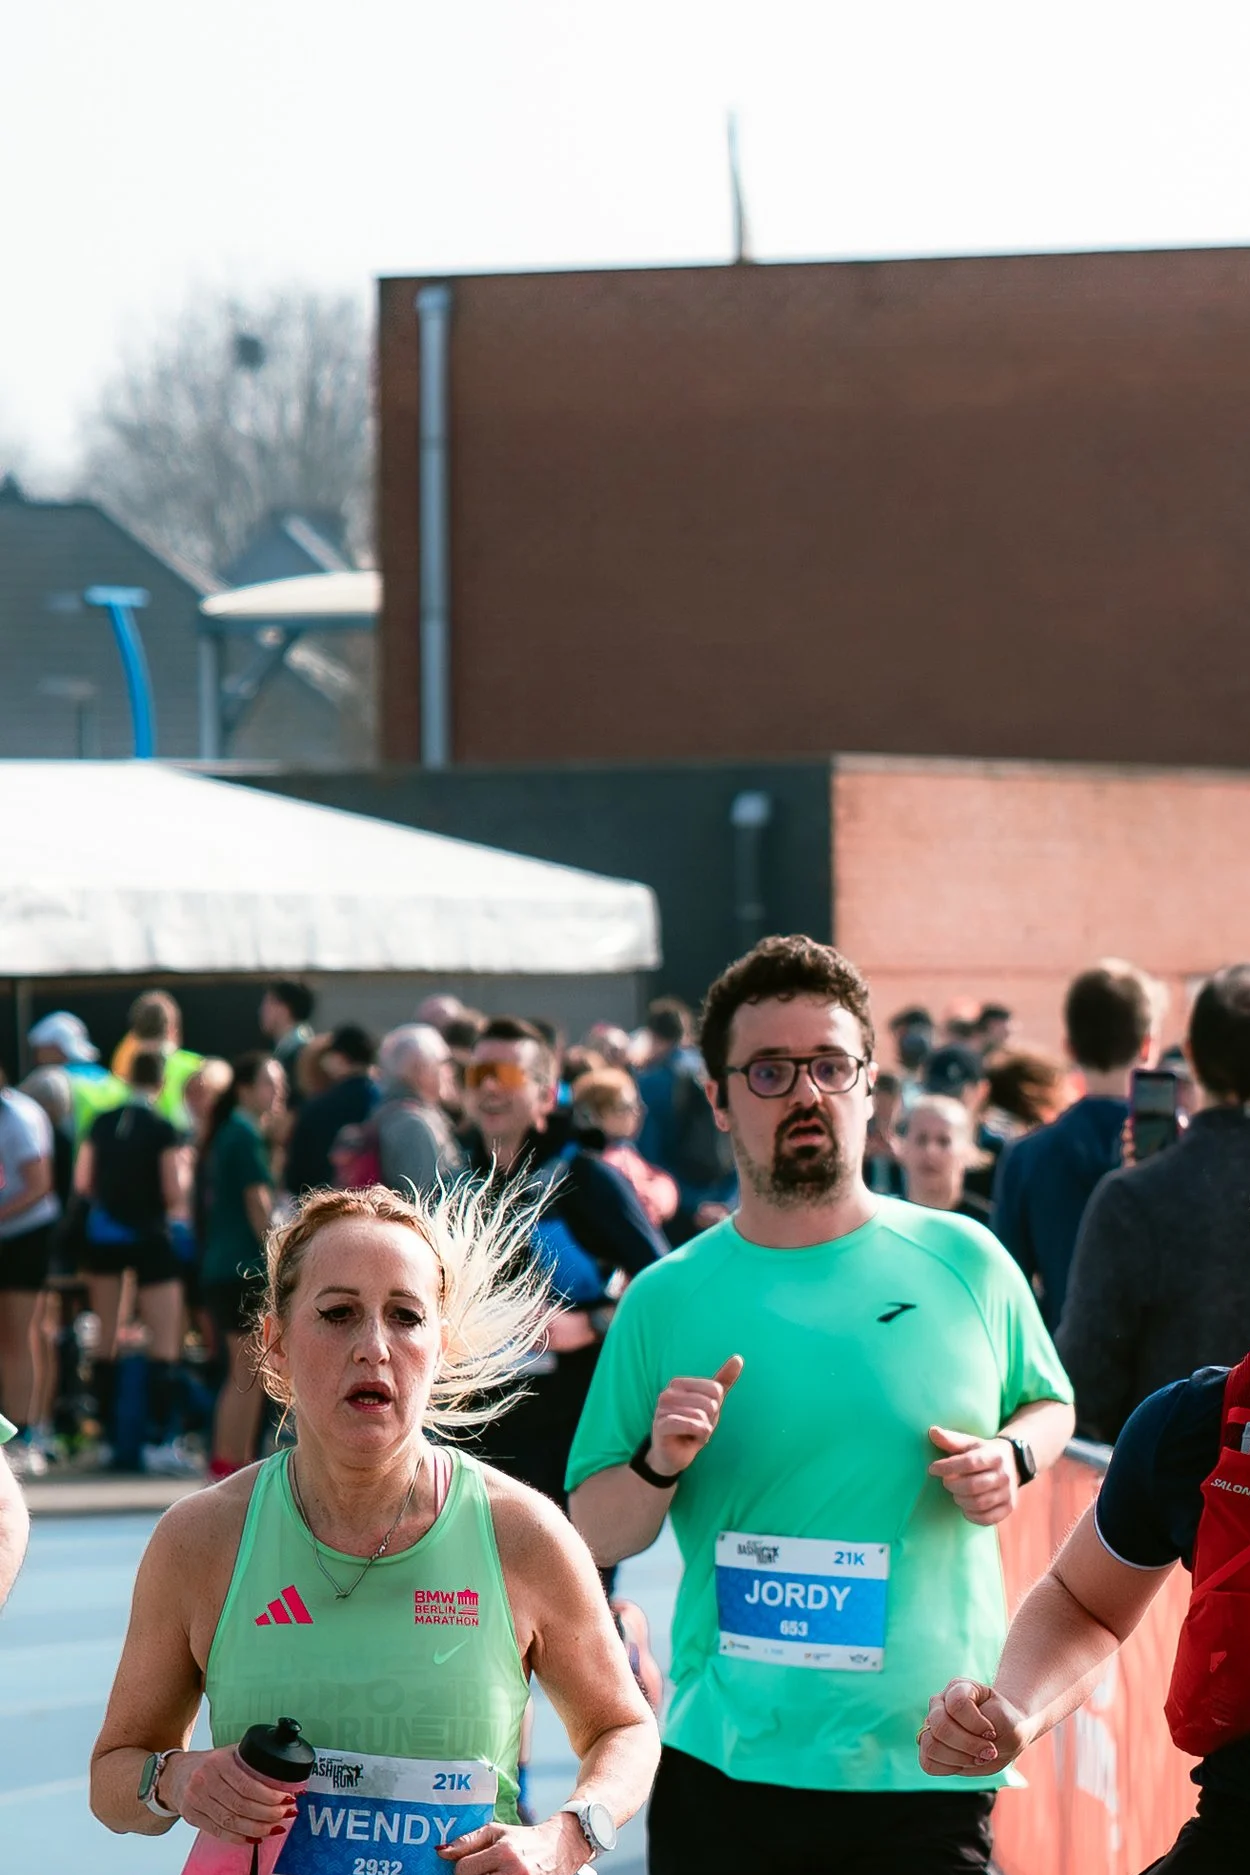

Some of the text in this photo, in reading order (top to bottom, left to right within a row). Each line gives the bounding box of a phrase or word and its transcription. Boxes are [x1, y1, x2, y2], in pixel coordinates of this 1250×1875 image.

[834, 1551, 865, 1566] 21K
[414, 1590, 455, 1603] BMW
[744, 1579, 851, 1611] JORDY
[414, 1604, 456, 1614] BERLIN
[414, 1615, 479, 1626] MARATHON
[432, 1773, 472, 1790] 21K
[307, 1804, 457, 1845] WENDY
